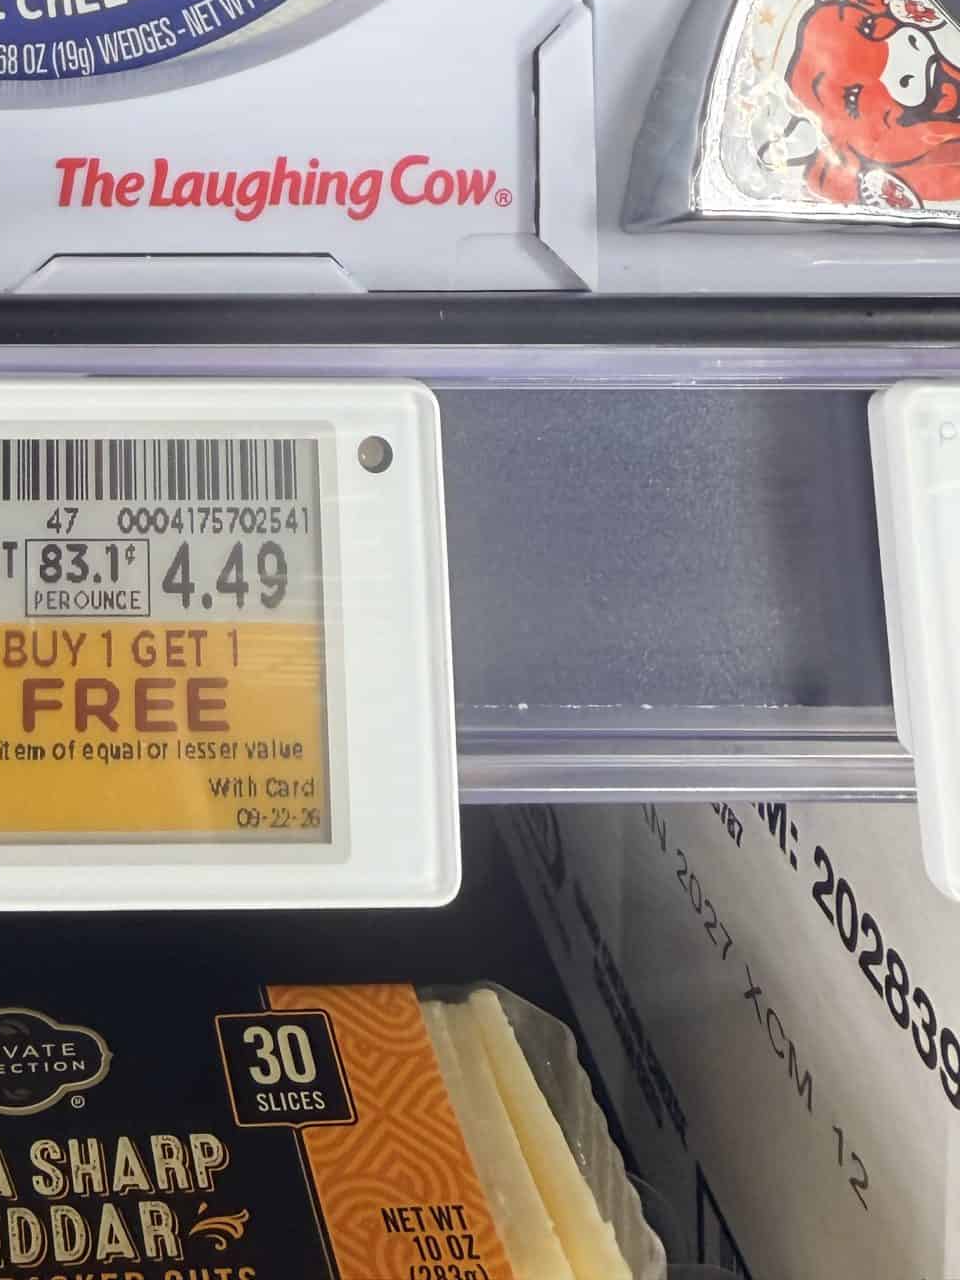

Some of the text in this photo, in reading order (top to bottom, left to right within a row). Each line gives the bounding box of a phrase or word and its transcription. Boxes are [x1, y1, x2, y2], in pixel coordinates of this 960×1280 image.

[23, 43, 48, 74] OZ
[52, 37, 95, 78] (19g)
[97, 16, 177, 64] WEDGES
[55, 157, 145, 208] The
[149, 156, 383, 222] Laughing
[46, 506, 309, 535] 47 0004175702541
[162, 540, 288, 609] 4.49
[3, 629, 240, 668] BUY 1 GET 1
[22, 677, 231, 733] FREE
[0, 740, 46, 761] item
[52, 739, 76, 761] of
[82, 740, 142, 765] equal
[147, 743, 168, 761] or
[177, 740, 239, 761] lesser
[245, 740, 304, 761] value
[209, 776, 315, 798] With Card
[676, 848, 734, 961] 2027
[832, 1123, 870, 1212] 12
[243, 1024, 317, 1085] 30
[256, 1090, 326, 1113] SLICES
[29, 1133, 230, 1200] SHARP
[381, 1205, 468, 1232] NET WT
[412, 1234, 481, 1262] 10 OZ
